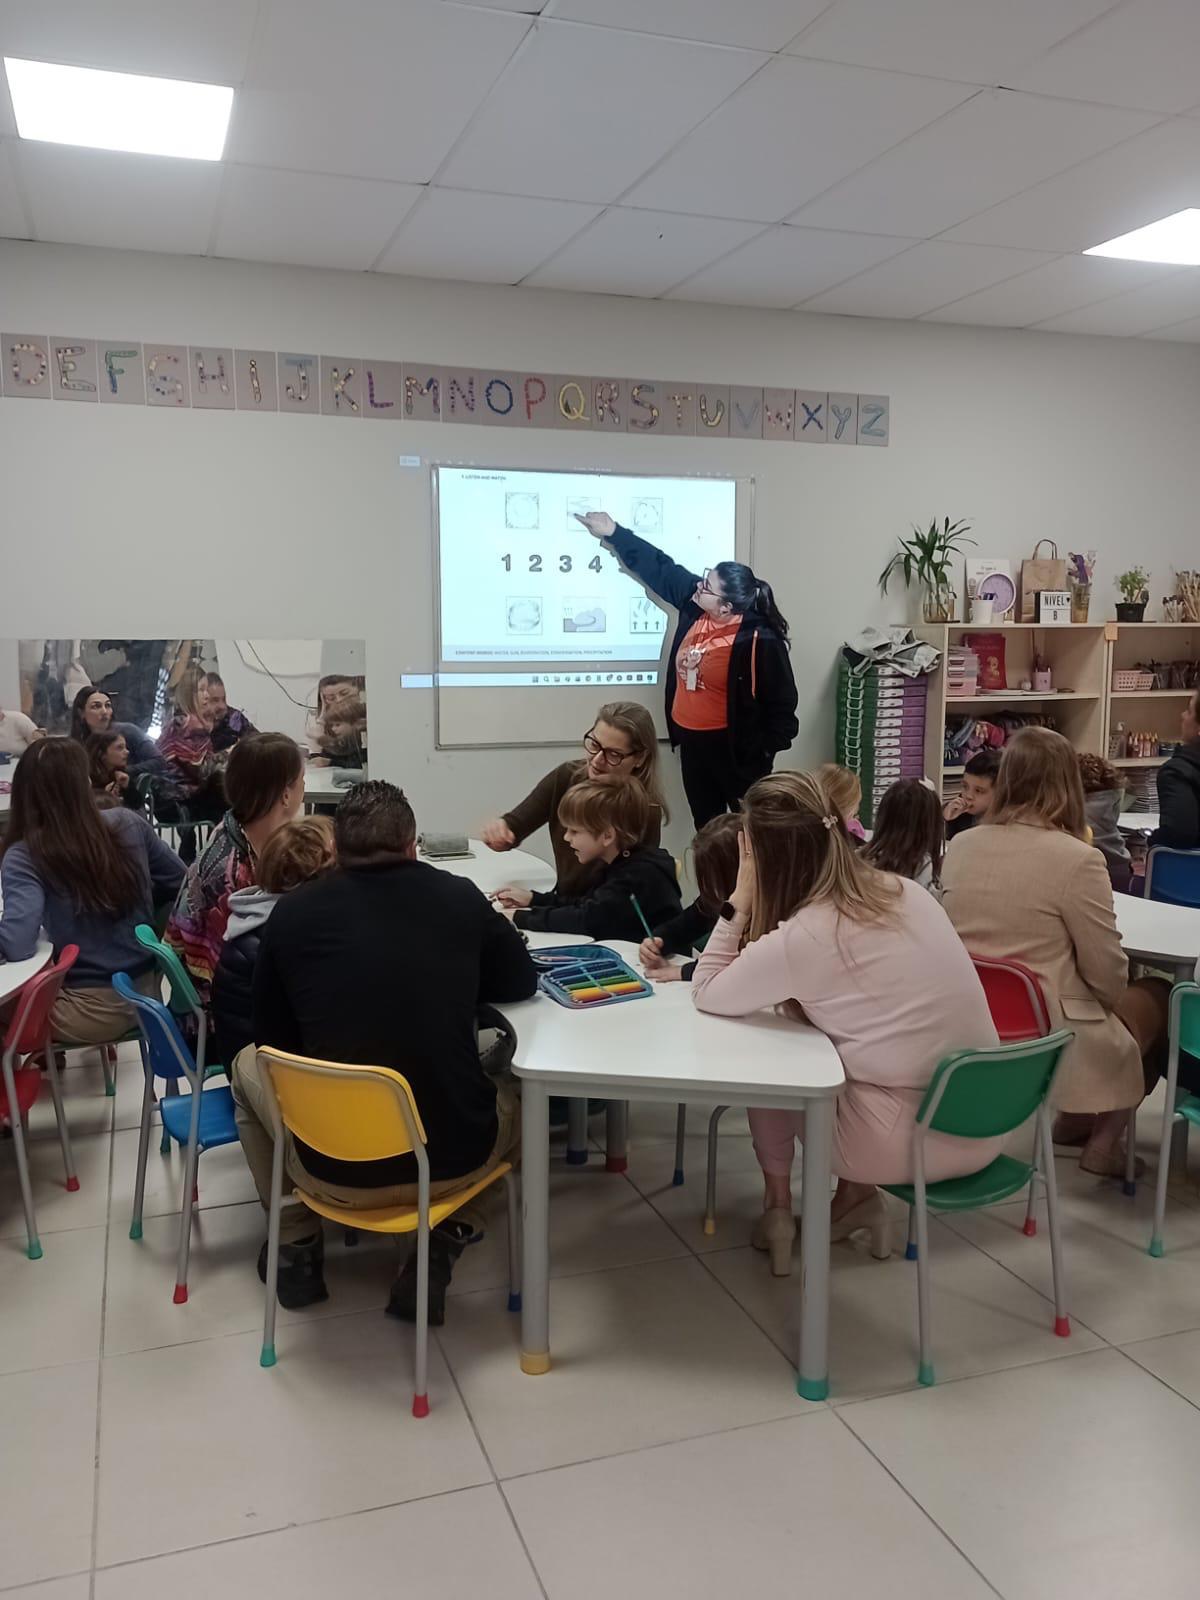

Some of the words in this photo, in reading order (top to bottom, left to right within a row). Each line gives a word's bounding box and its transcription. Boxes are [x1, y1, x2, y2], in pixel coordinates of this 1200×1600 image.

[10, 343, 47, 386] D
[56, 346, 96, 392] E
[105, 350, 138, 393] F
[149, 352, 184, 403] G
[195, 351, 230, 395] H
[250, 360, 262, 403] I
[285, 359, 313, 401] J
[332, 367, 359, 411] K
[367, 371, 394, 408] L
[405, 376, 441, 415] M
[448, 376, 475, 415] N
[485, 379, 513, 415] O
[524, 377, 546, 419] P
[559, 382, 590, 421] Q
[594, 382, 619, 424] R
[630, 384, 660, 429] S
[667, 392, 692, 427] T
[700, 394, 725, 427] U
[735, 402, 759, 429] V
[765, 403, 792, 431] W
[801, 402, 824, 430] X
[831, 405, 852, 440] Y
[861, 403, 888, 438] Z
[501, 554, 511, 571] 1
[528, 554, 542, 572] 2
[559, 555, 572, 573] 3
[588, 555, 602, 573] 4
[1044, 595, 1065, 605] NIVEL
[1053, 610, 1058, 620] B
